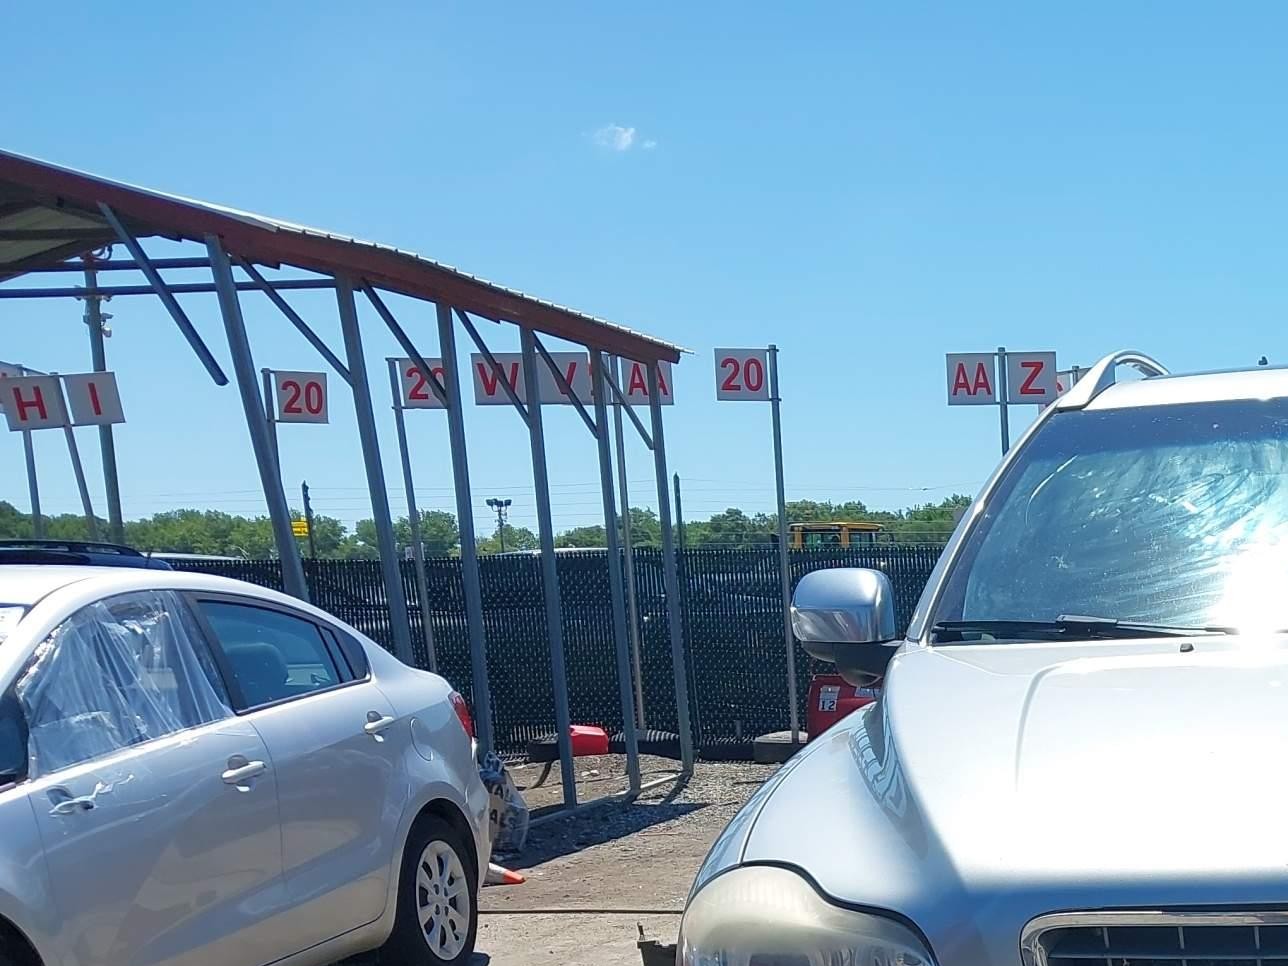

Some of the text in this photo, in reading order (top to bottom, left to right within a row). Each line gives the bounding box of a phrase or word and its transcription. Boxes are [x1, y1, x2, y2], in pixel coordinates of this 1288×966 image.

[477, 362, 519, 395] W
[721, 358, 763, 391] 20
[952, 362, 992, 395] AA
[1020, 361, 1045, 394] Z
[12, 386, 47, 420] H
[88, 382, 101, 416] I
[281, 380, 323, 414] 20
